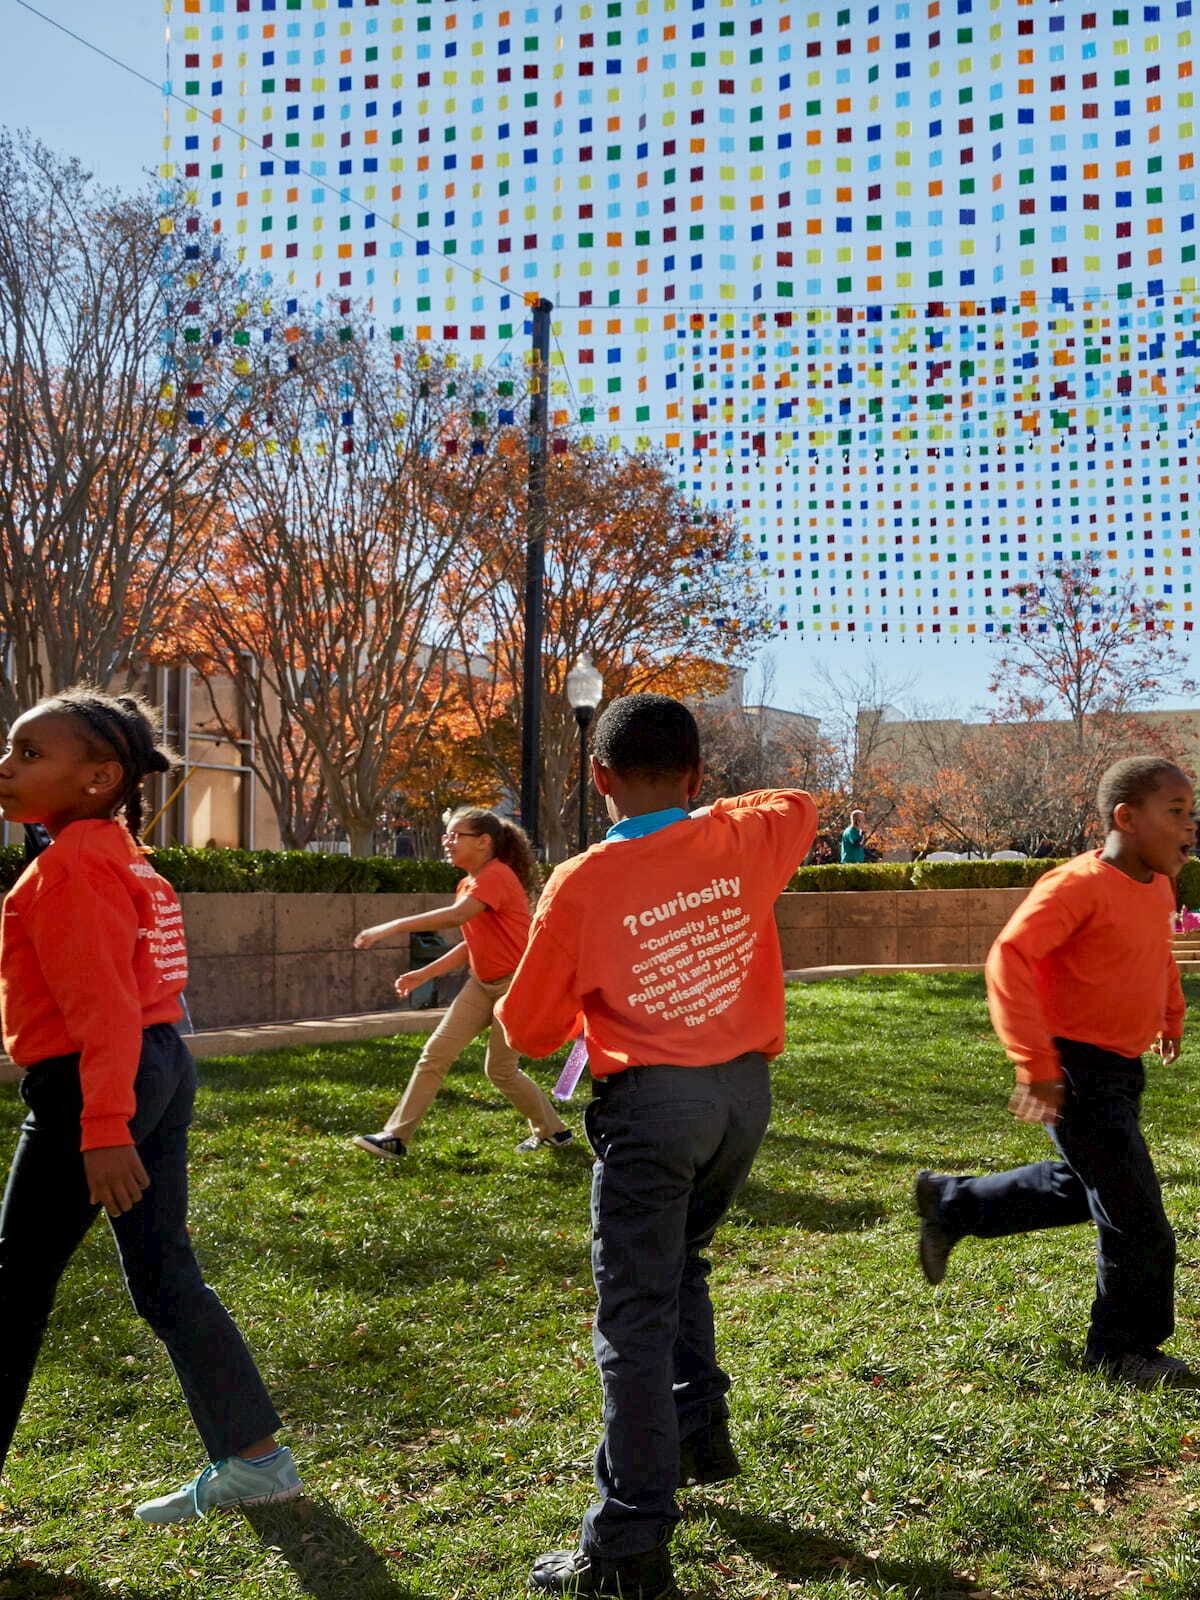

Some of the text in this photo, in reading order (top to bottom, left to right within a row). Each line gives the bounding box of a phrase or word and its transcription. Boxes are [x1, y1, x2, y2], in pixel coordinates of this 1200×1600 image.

[707, 914, 720, 926] is
[721, 906, 742, 921] the
[632, 914, 751, 975] compass that leads
[627, 979, 678, 1007] Follow
[677, 971, 691, 985] it
[689, 959, 711, 978] and
[713, 951, 735, 970] you
[639, 972, 660, 985] us
[659, 966, 676, 977] to
[675, 953, 695, 969] our
[644, 1001, 666, 1016] be
[662, 996, 706, 1021] future
[684, 1013, 706, 1028] the
